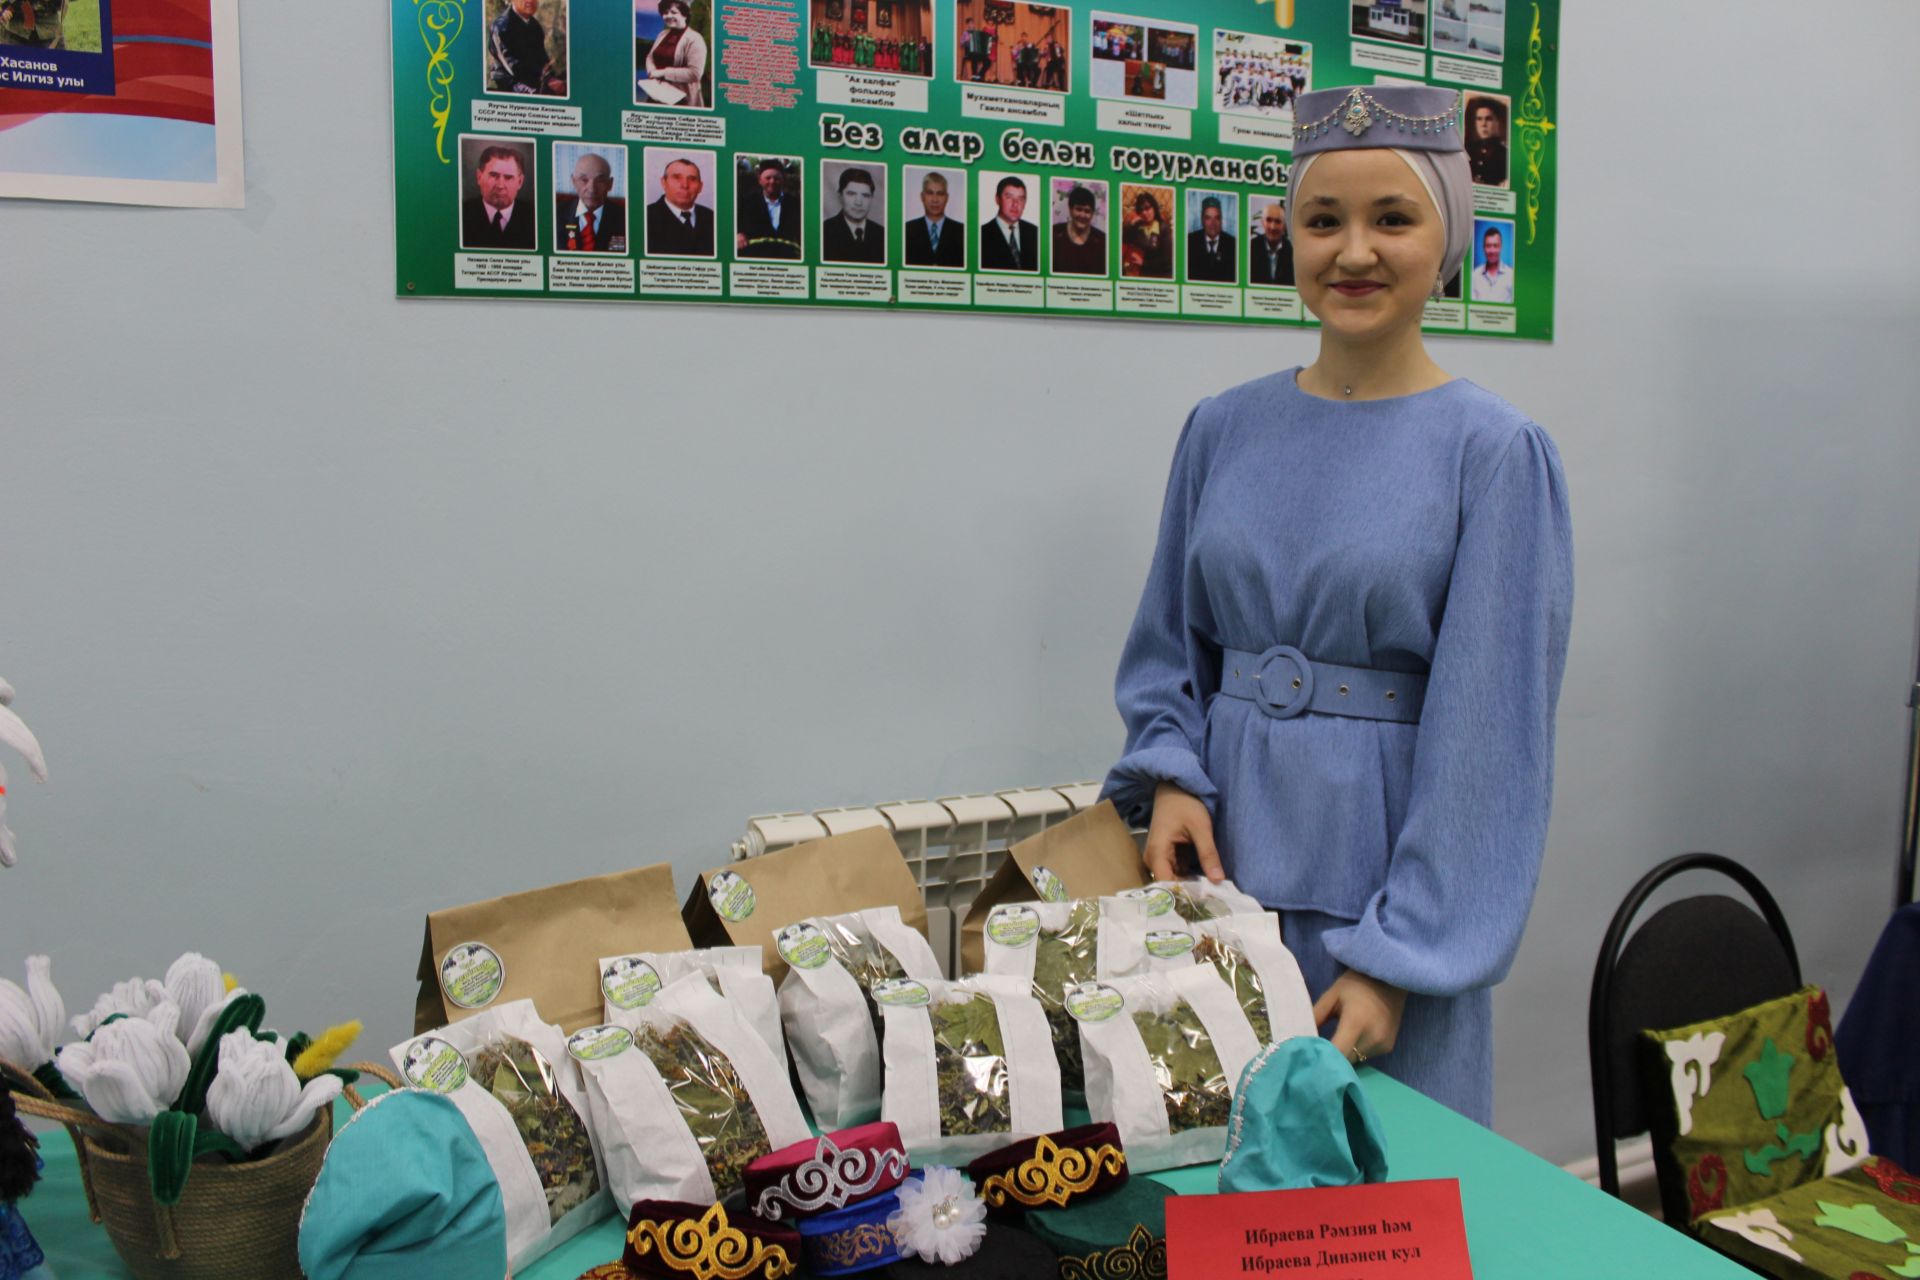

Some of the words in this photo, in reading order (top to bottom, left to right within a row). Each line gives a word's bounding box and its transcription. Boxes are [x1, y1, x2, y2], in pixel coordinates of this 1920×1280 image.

[0, 56, 58, 72] Хасанов
[13, 71, 54, 85] Илгиз
[57, 77, 84, 88] улы
[849, 86, 896, 97] фольклор
[821, 115, 882, 149] Без
[902, 127, 982, 161] алар
[1002, 130, 1093, 165] белән
[1112, 147, 1289, 185] горурланабы
[1244, 1228, 1315, 1248] Ибраева
[1319, 1223, 1378, 1240] Рәмзия
[1382, 1219, 1412, 1234] һәм
[1240, 1256, 1312, 1274] Ибраева
[1392, 1247, 1421, 1263] кул
